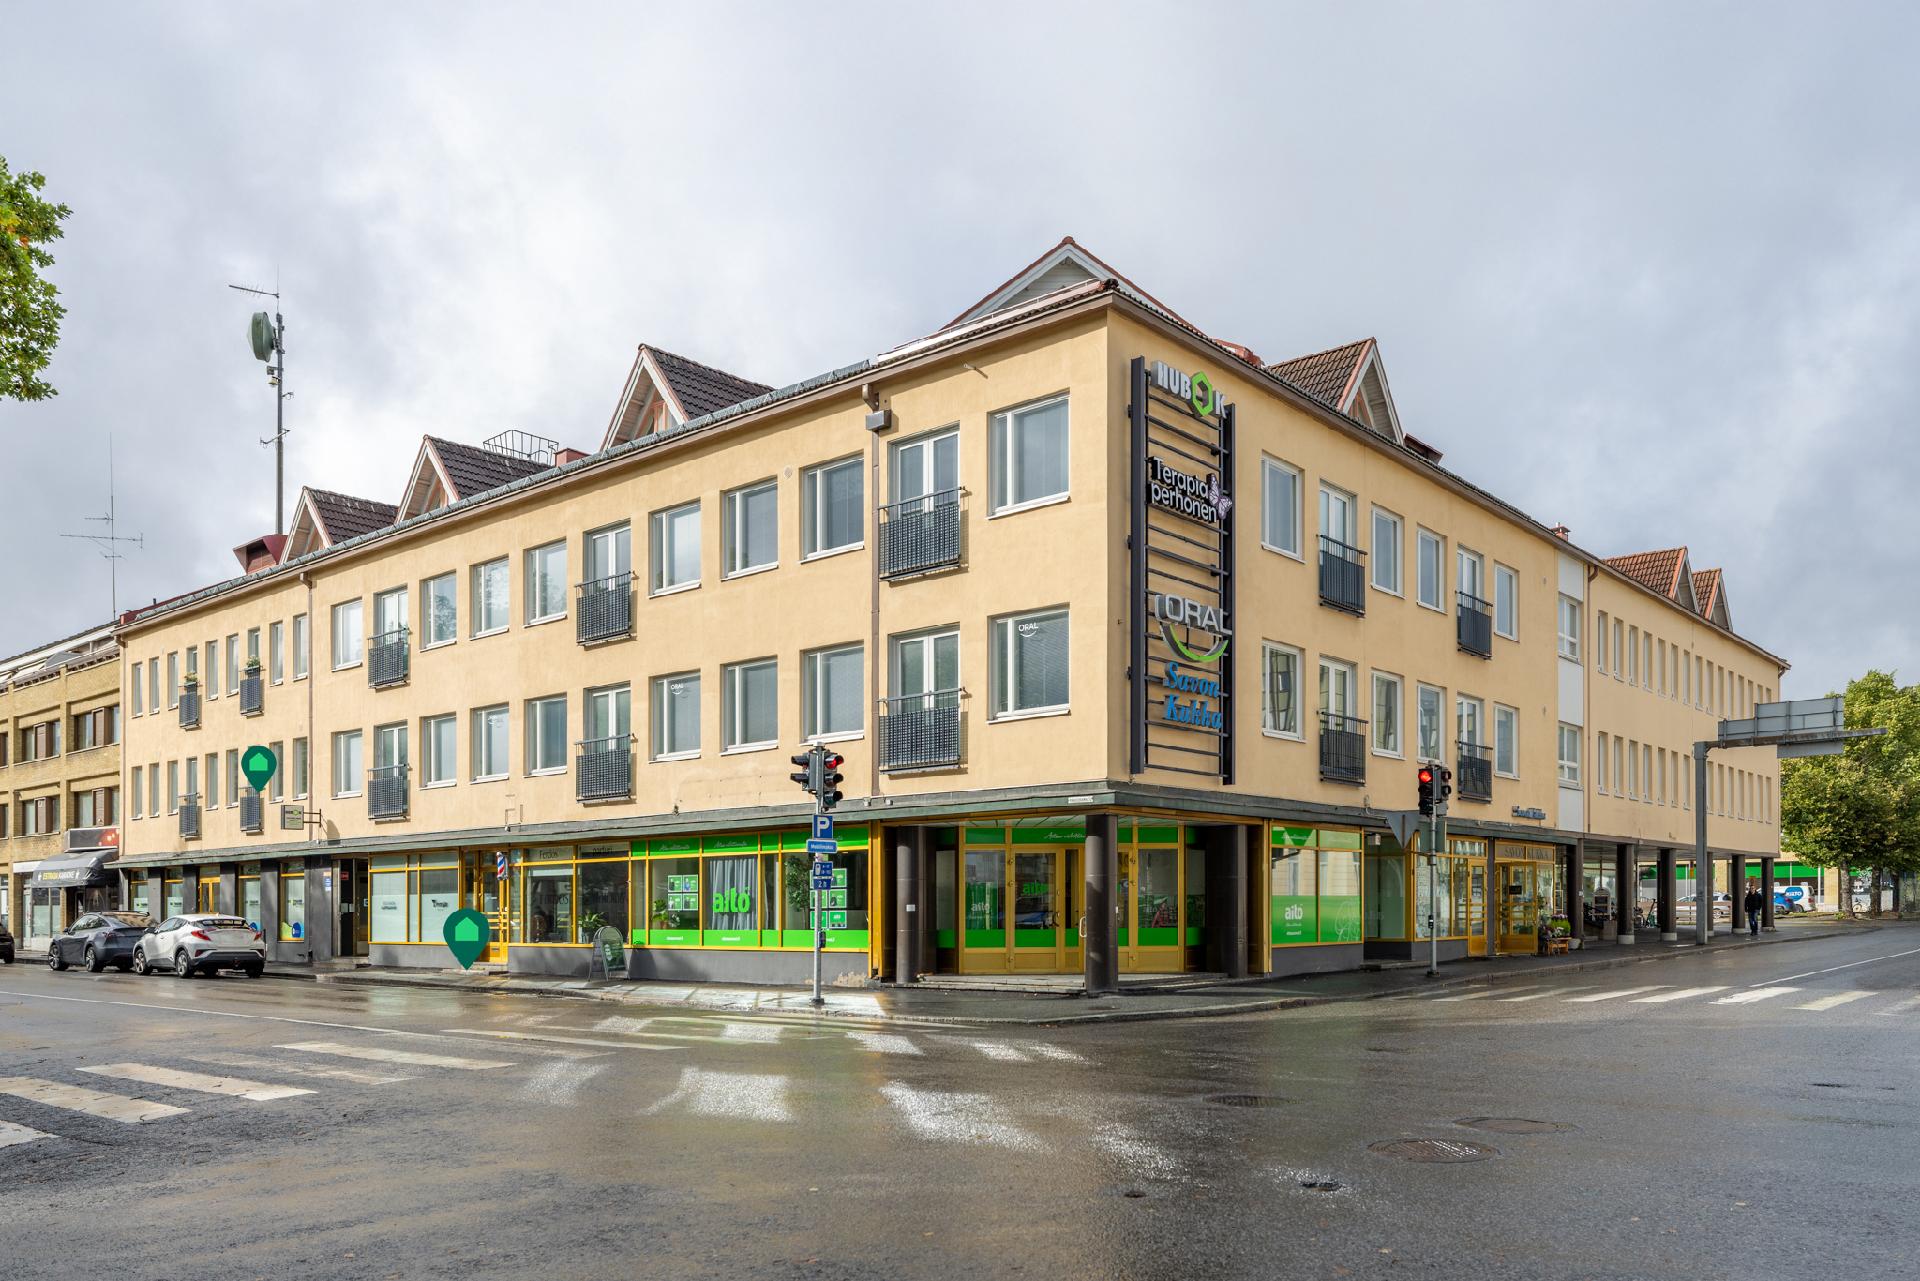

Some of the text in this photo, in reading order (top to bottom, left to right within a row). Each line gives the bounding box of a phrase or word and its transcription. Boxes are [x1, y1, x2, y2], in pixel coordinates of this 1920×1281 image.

[1153, 457, 1209, 499] Terapia
[1150, 482, 1218, 523] perhonen
[1018, 622, 1039, 632] ORAL
[1163, 593, 1233, 636] ORAL
[1166, 661, 1221, 699] Savon
[1165, 694, 1224, 730] Kukka
[816, 816, 830, 838] P
[713, 887, 750, 913] aito
[1284, 904, 1304, 921] aito
